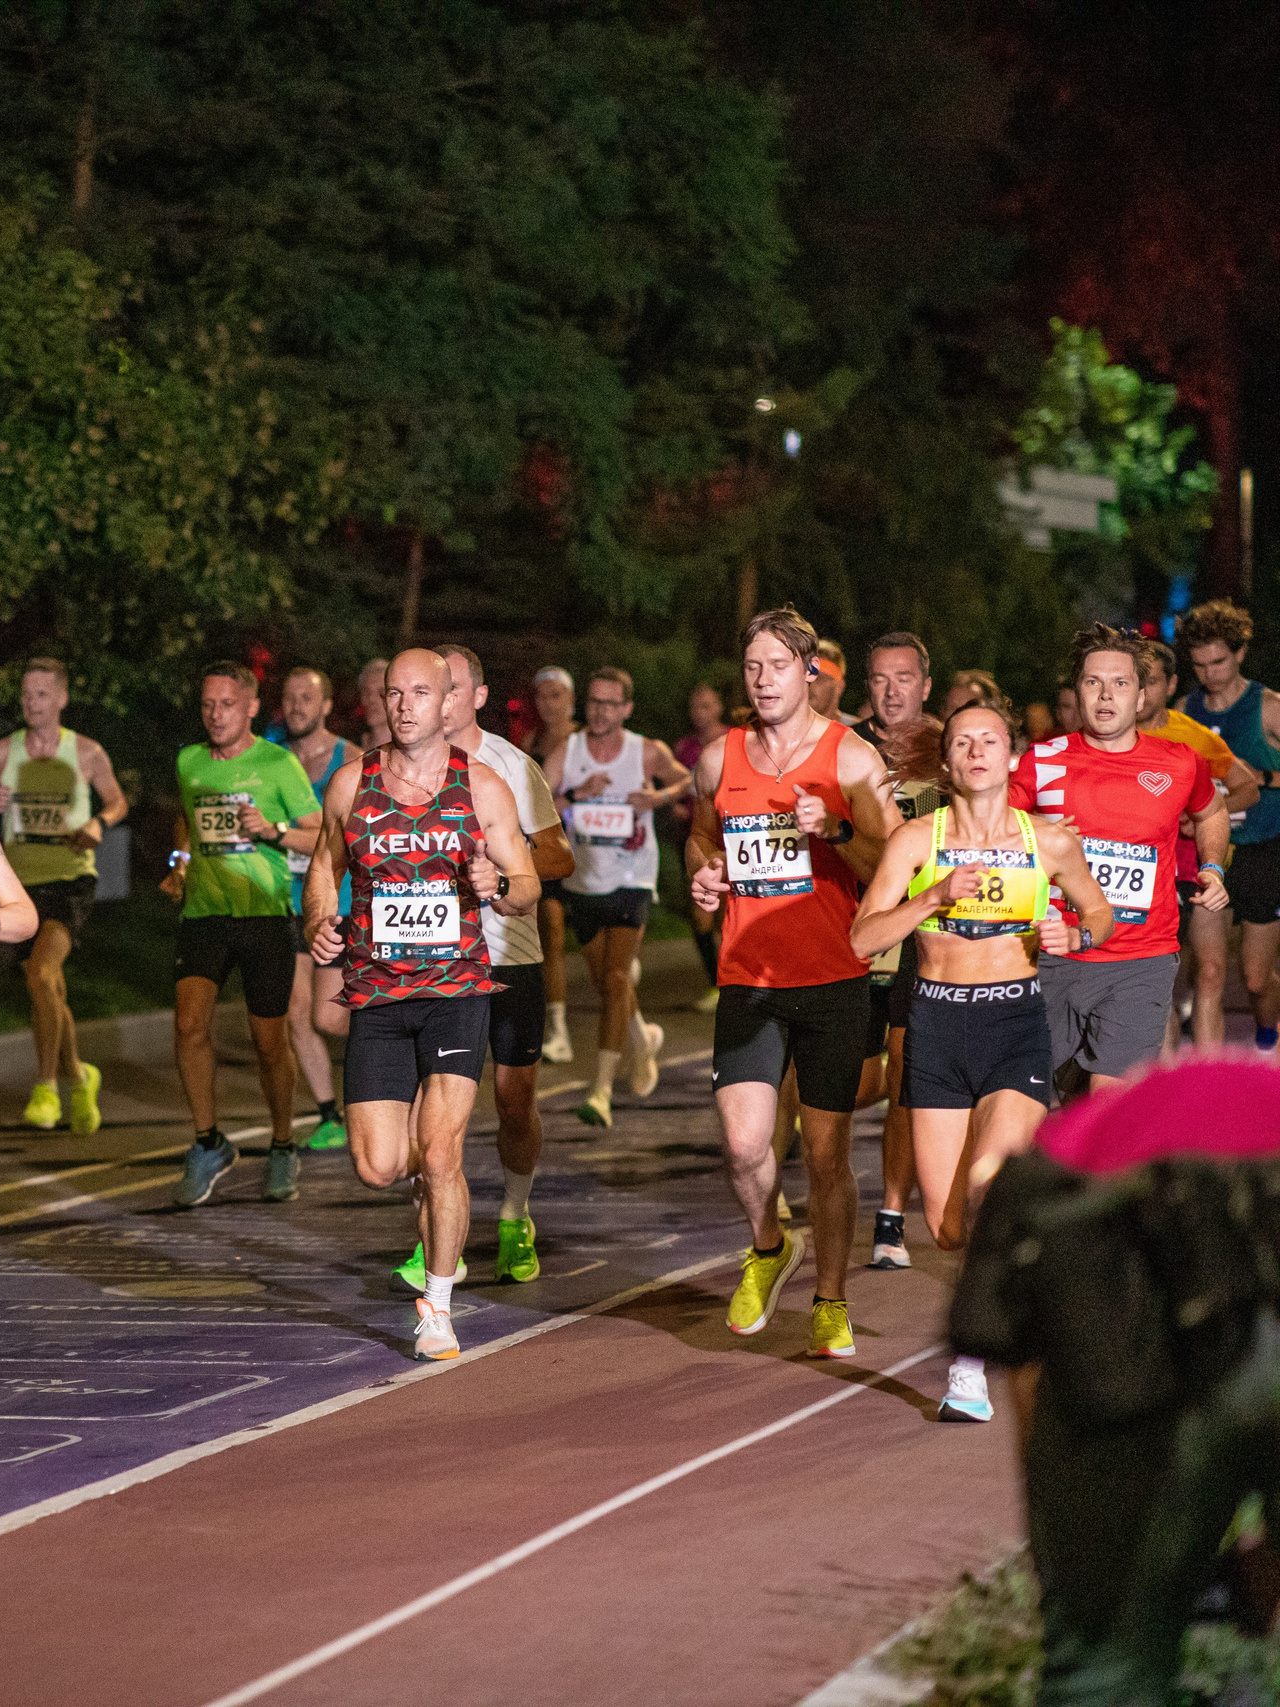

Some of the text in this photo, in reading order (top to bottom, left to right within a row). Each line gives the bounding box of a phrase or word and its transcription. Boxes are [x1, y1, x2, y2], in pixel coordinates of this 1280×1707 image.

[201, 812, 236, 830] 528
[370, 831, 462, 855] KENYA
[737, 836, 799, 865] 6178
[751, 864, 784, 876] АНДРЕЙ
[384, 904, 449, 929] 2449
[956, 905, 1014, 915] ВАЛЕНТИНА
[398, 930, 434, 938] МИХАИЛ
[381, 944, 392, 959] B
[919, 981, 970, 1003] NIKE
[971, 984, 1024, 1003] PRO
